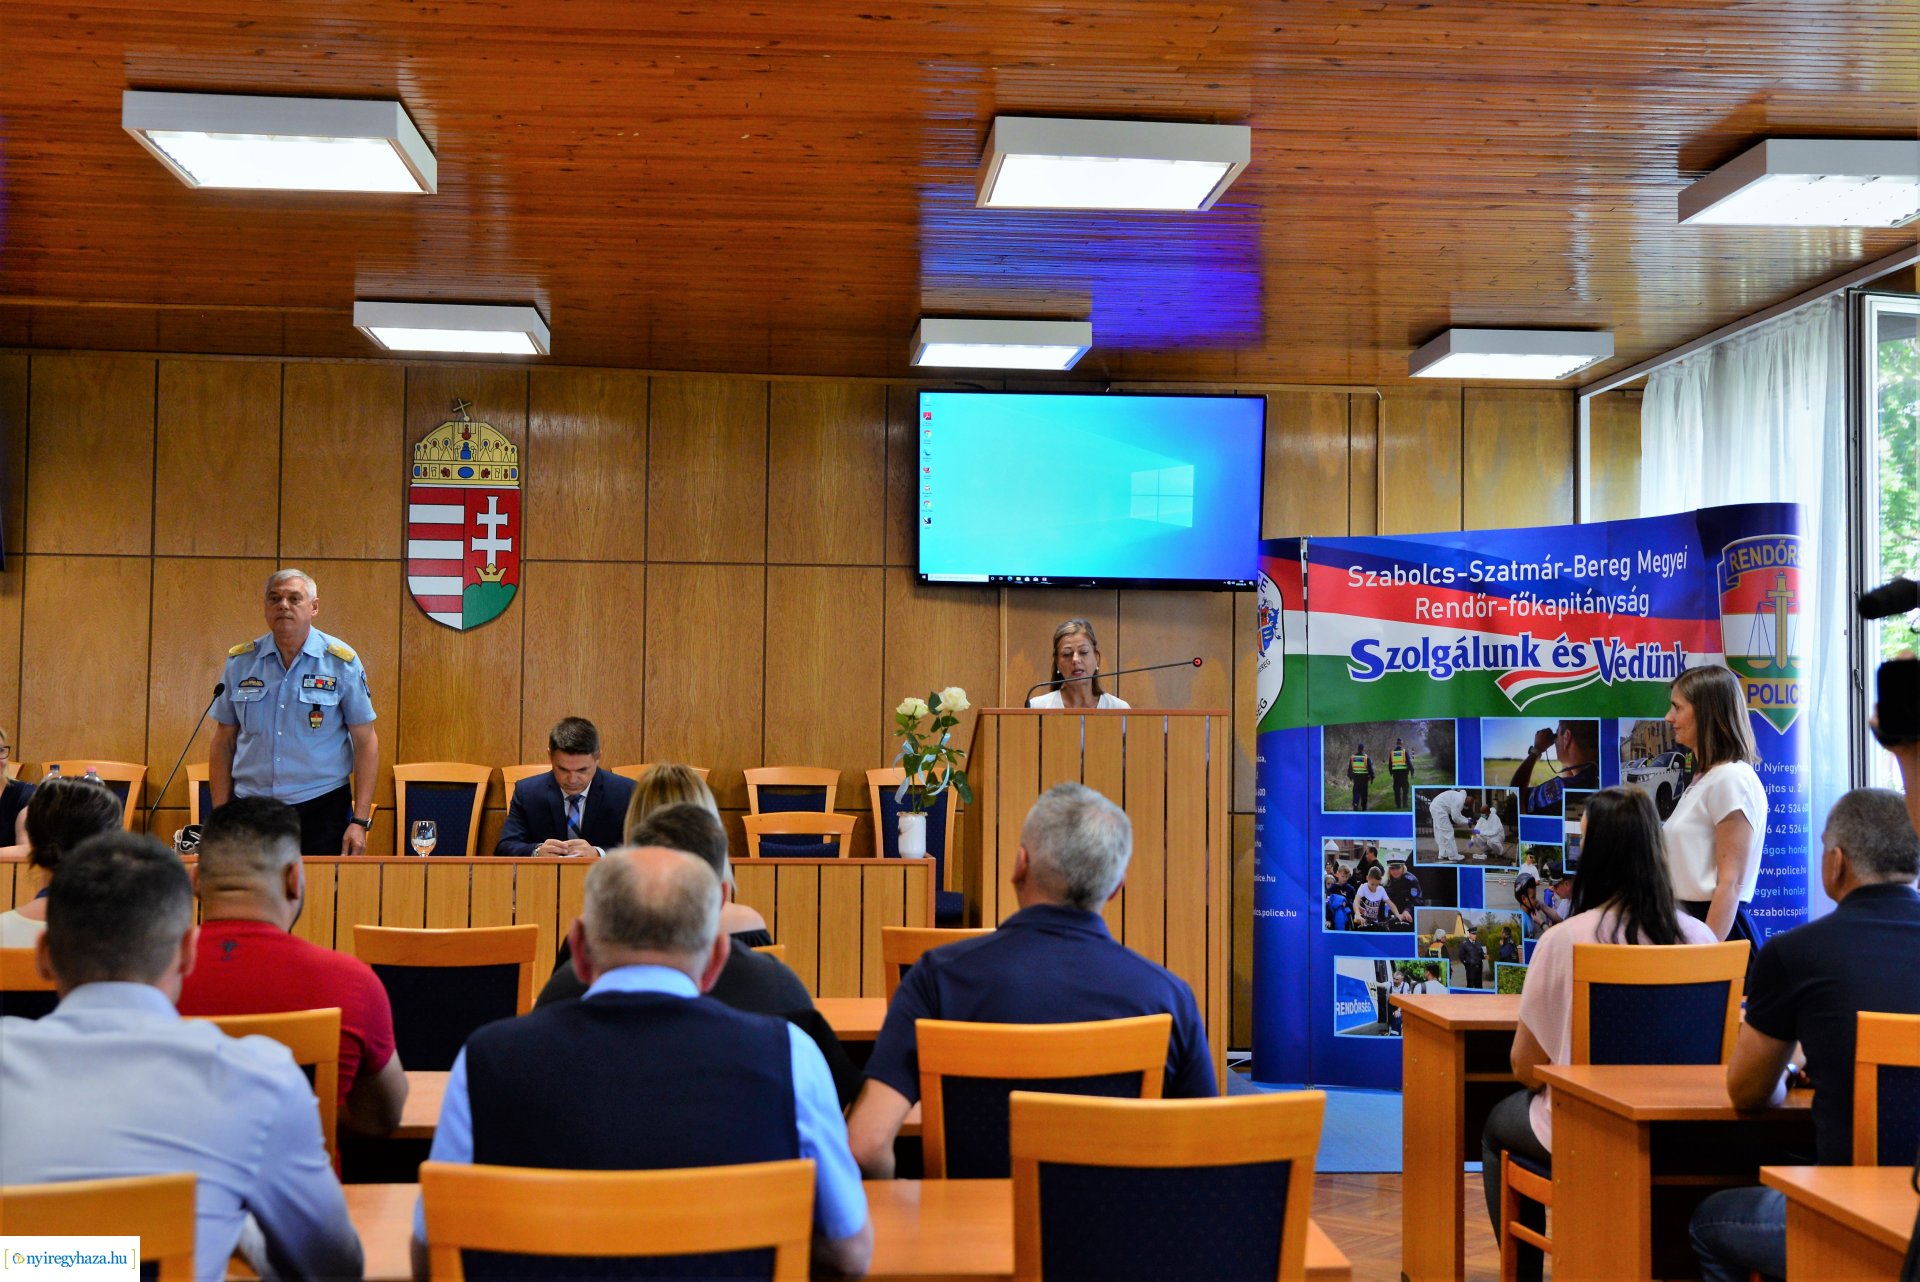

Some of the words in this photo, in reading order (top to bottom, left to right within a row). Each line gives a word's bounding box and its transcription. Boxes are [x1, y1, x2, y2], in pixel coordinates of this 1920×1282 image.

[1348, 553, 1631, 588] Szabolcs-Szatmár-Bereg
[1638, 544, 1688, 578] Megyei
[1415, 585, 1649, 621] Rendőr-főkapitányság
[1349, 633, 1542, 681] Szolgálunk
[1551, 634, 1588, 669] és
[1591, 638, 1687, 684] Védünk
[1774, 804, 1786, 814] 42
[1775, 825, 1787, 834] 42
